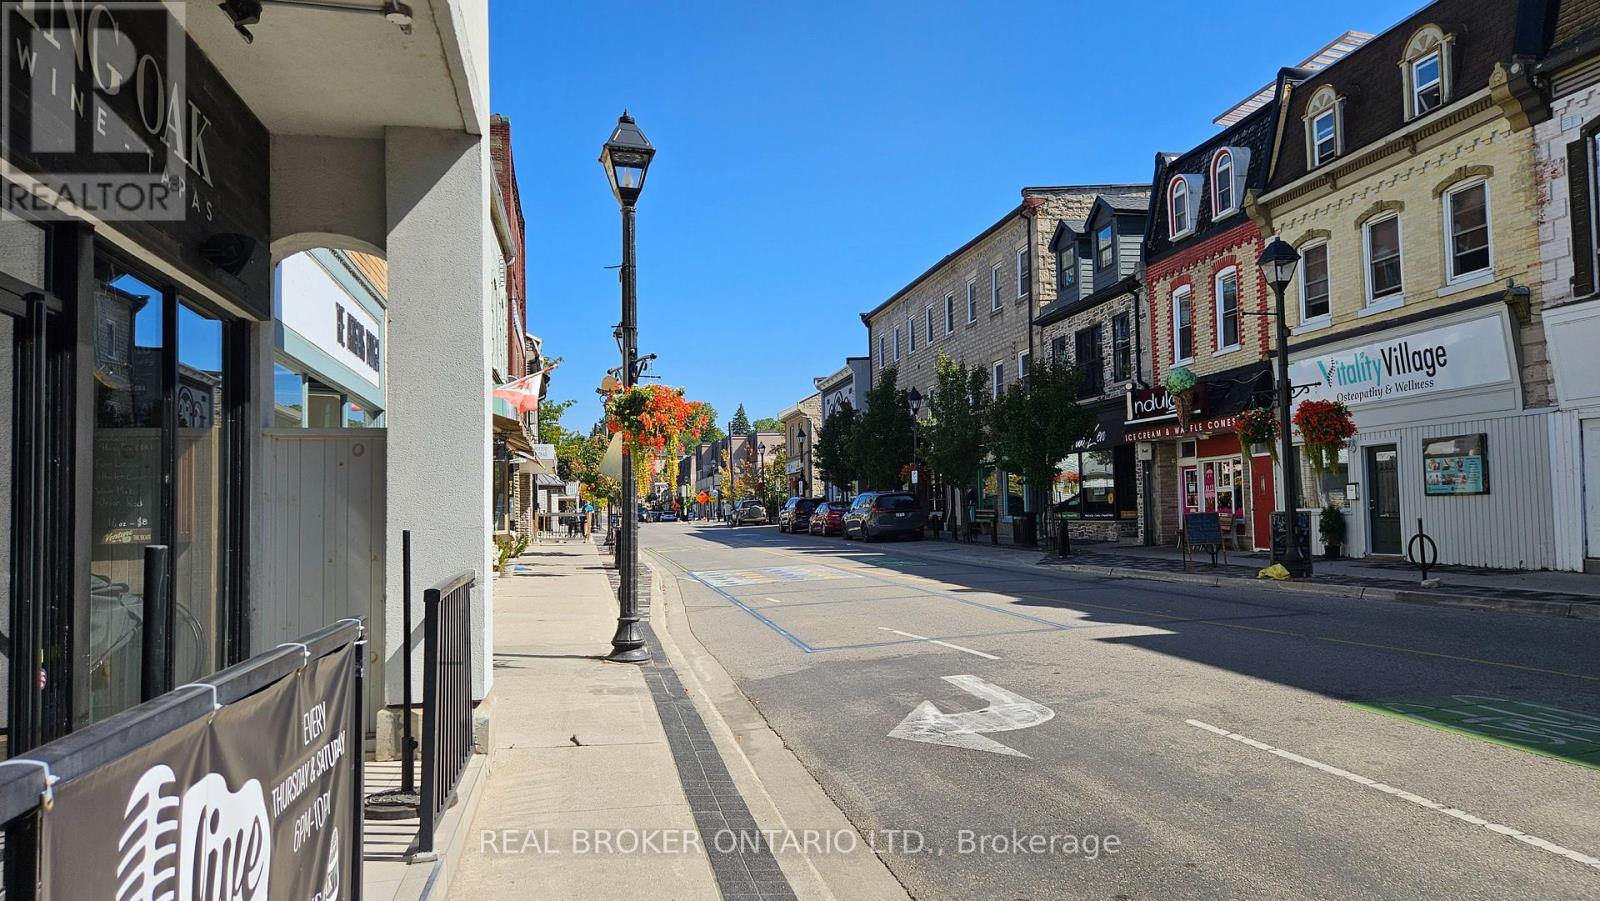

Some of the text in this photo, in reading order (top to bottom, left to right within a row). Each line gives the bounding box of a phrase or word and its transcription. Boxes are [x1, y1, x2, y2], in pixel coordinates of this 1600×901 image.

[16, 37, 108, 137] WINE
[146, 148, 213, 222] TAPAS
[136, 54, 214, 188] OAK
[1380, 341, 1447, 378] Village
[1125, 382, 1177, 421] Indul
[1336, 379, 1434, 403] Osteopathy & Wellness
[1124, 433, 1137, 443] ICE
[1137, 429, 1162, 441] CREAM
[1174, 423, 1203, 435] WAFLE
[1207, 417, 1236, 430] CONES
[303, 701, 326, 745] EVERY
[271, 761, 311, 818] THURSDAY
[310, 755, 317, 784] &
[191, 804, 264, 901] live
